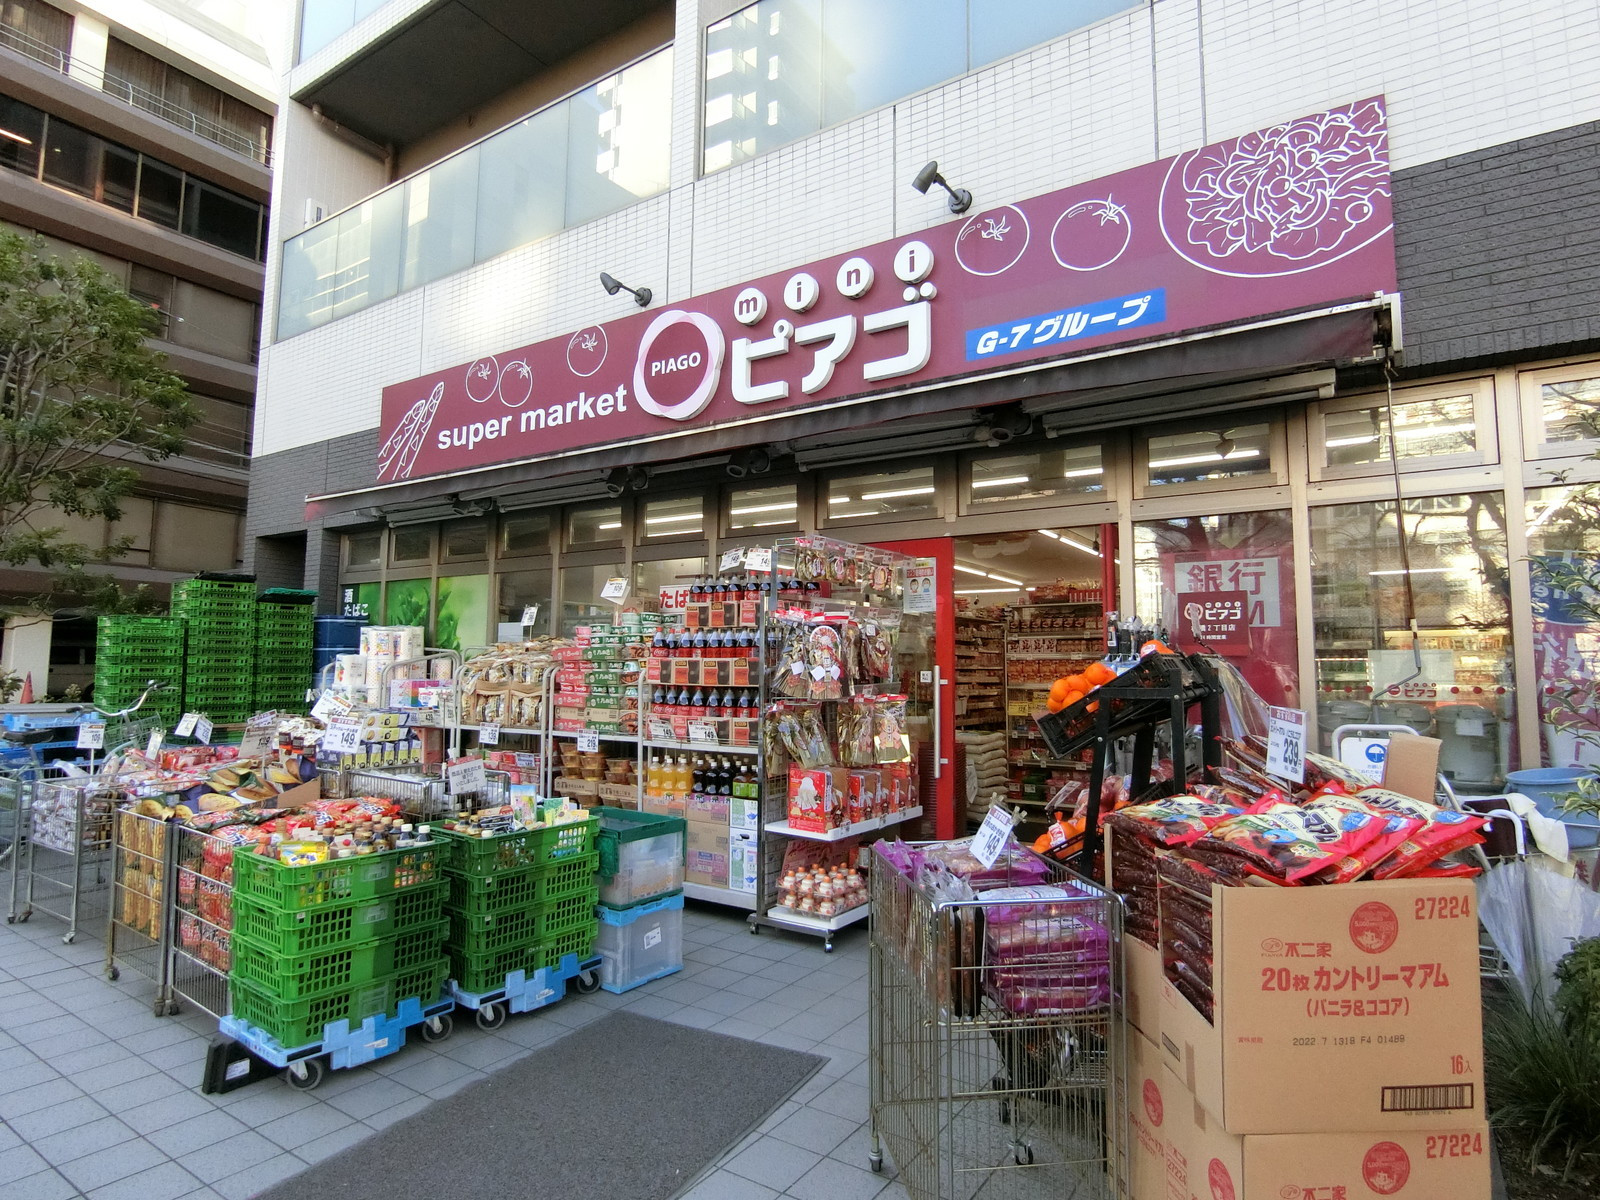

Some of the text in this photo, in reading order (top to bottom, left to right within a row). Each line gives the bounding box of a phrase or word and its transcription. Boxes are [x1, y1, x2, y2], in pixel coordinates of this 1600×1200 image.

[737, 248, 920, 314] mini
[731, 281, 937, 404] ピアゴ
[650, 351, 702, 377] PIAGO
[437, 382, 628, 450] super market
[1187, 562, 1266, 595] 銀行
[343, 603, 370, 617] たばこ
[660, 589, 689, 609] たば
[1204, 606, 1242, 620] ピアゴ
[340, 731, 356, 745] 149
[1283, 737, 1300, 767] 239
[983, 832, 1001, 856] 149
[1414, 895, 1471, 920] 27224
[1284, 942, 1332, 958] 不二家
[1261, 963, 1450, 992] 20枚 カントリーマアム
[1425, 1132, 1483, 1159] 27224
